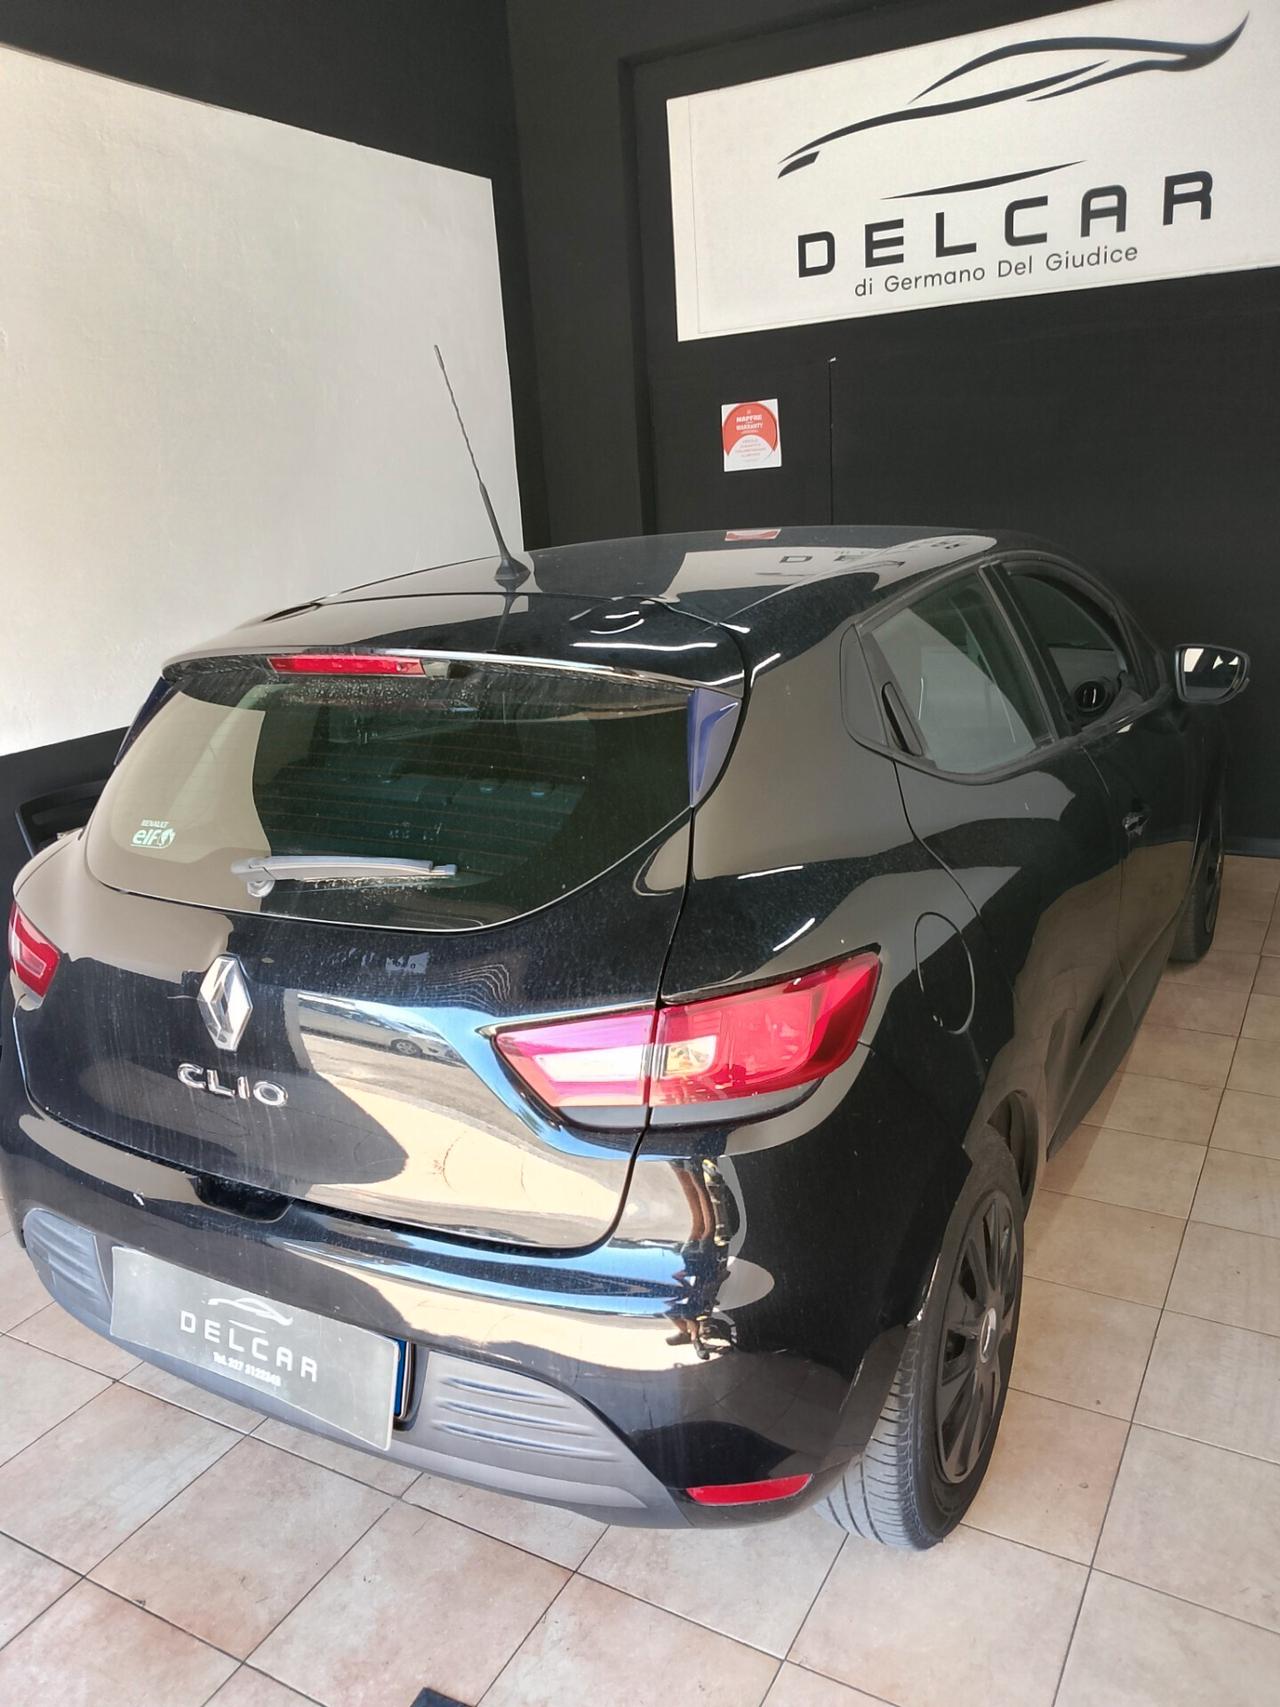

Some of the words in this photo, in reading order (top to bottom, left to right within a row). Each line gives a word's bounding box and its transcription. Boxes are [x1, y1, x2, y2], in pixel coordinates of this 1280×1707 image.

[798, 170, 1213, 278] DELCAR
[854, 278, 873, 297] di
[884, 265, 986, 293] Germano
[998, 257, 1033, 278] Del
[1045, 245, 1139, 271] Giudice
[177, 1062, 289, 1107] CLIO
[180, 1310, 318, 1382] DELCAR
